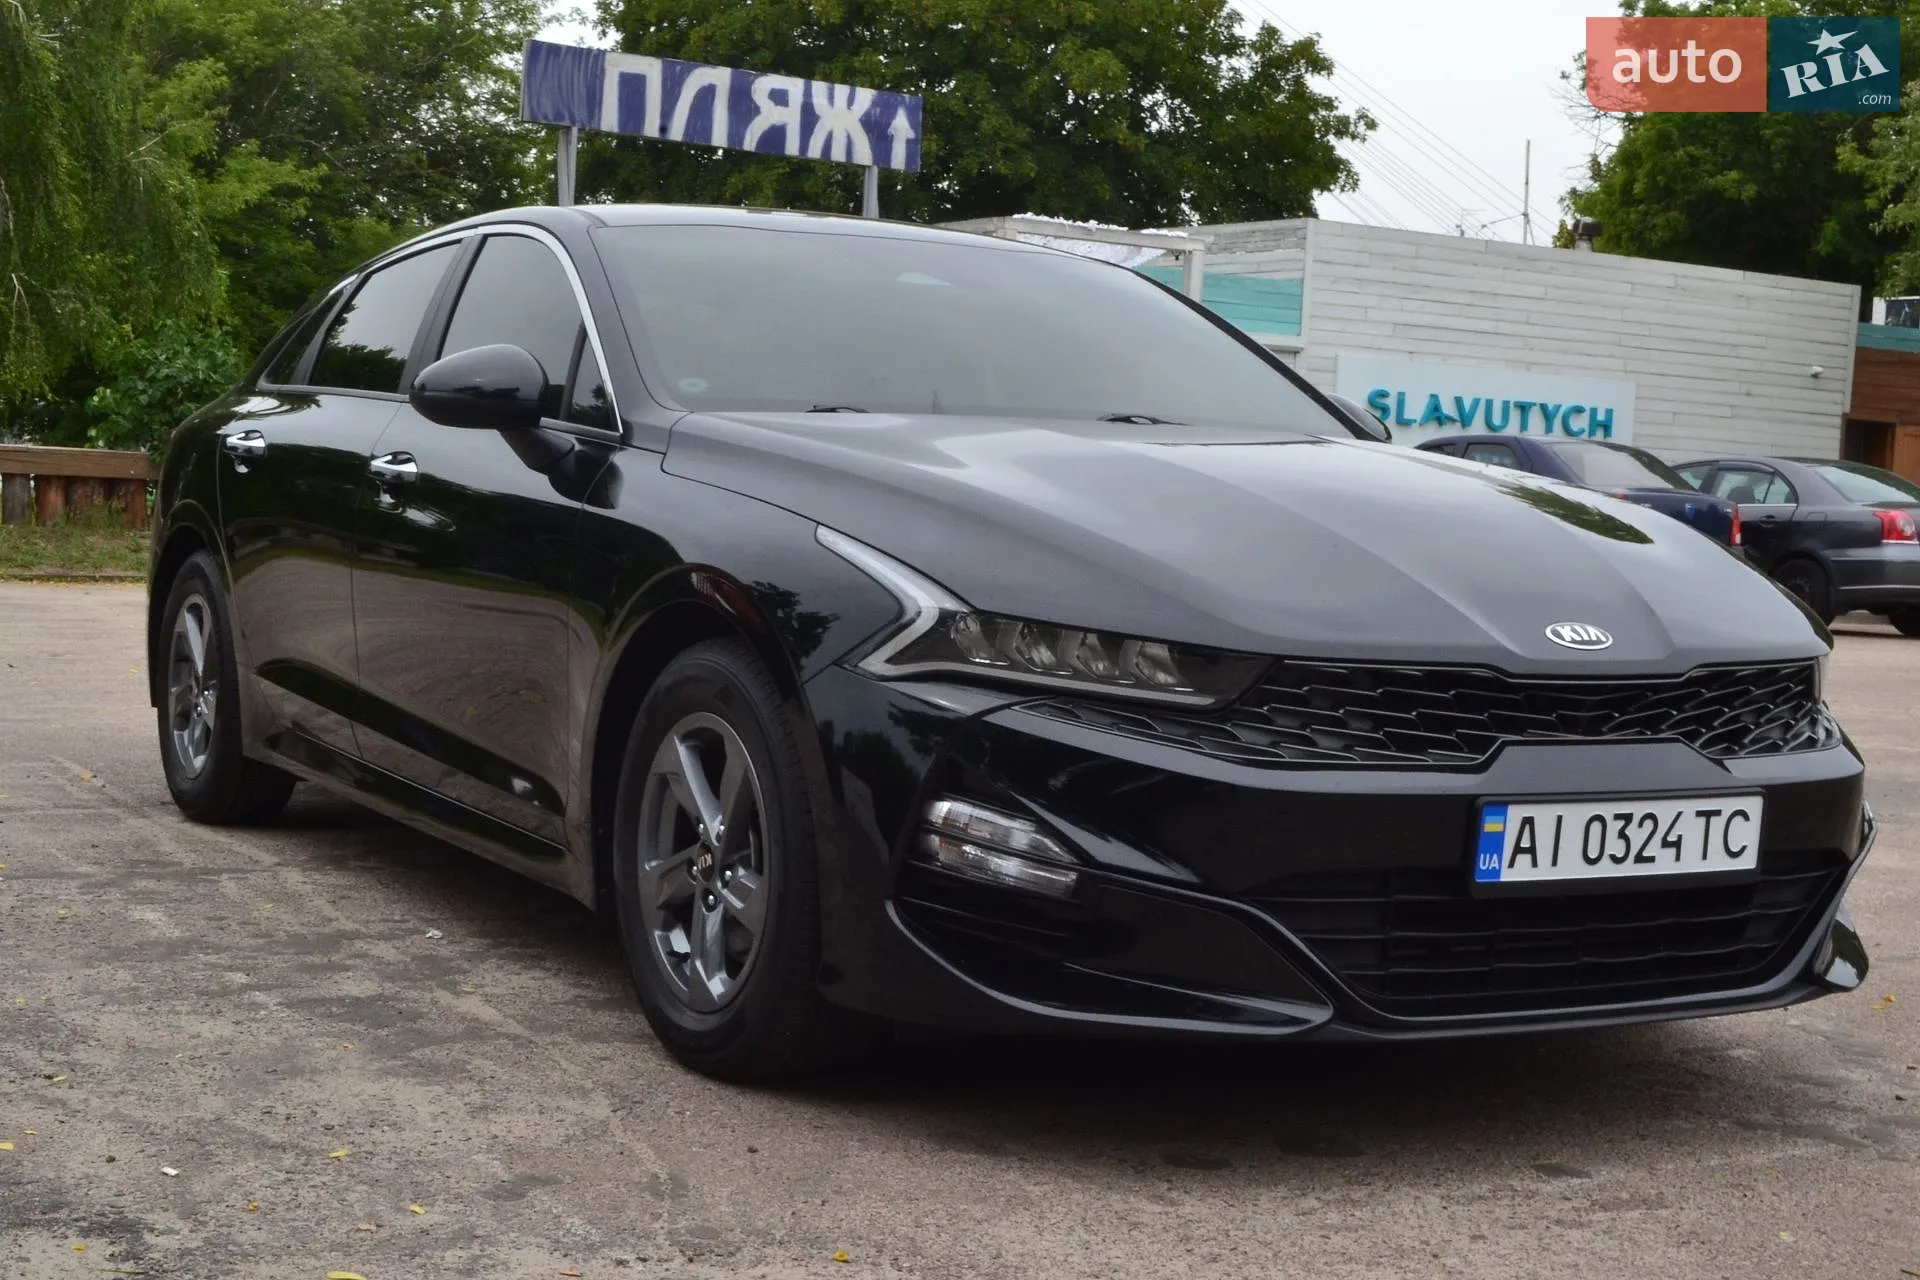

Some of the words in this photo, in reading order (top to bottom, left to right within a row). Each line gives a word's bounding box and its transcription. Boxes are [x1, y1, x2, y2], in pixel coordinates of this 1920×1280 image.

[602, 51, 876, 165] ПЛЯЖ
[1367, 388, 1615, 439] SLAVUTYCH
[1555, 625, 1607, 642] KIA
[1479, 853, 1500, 871] UA
[1582, 810, 1684, 866] 0324
